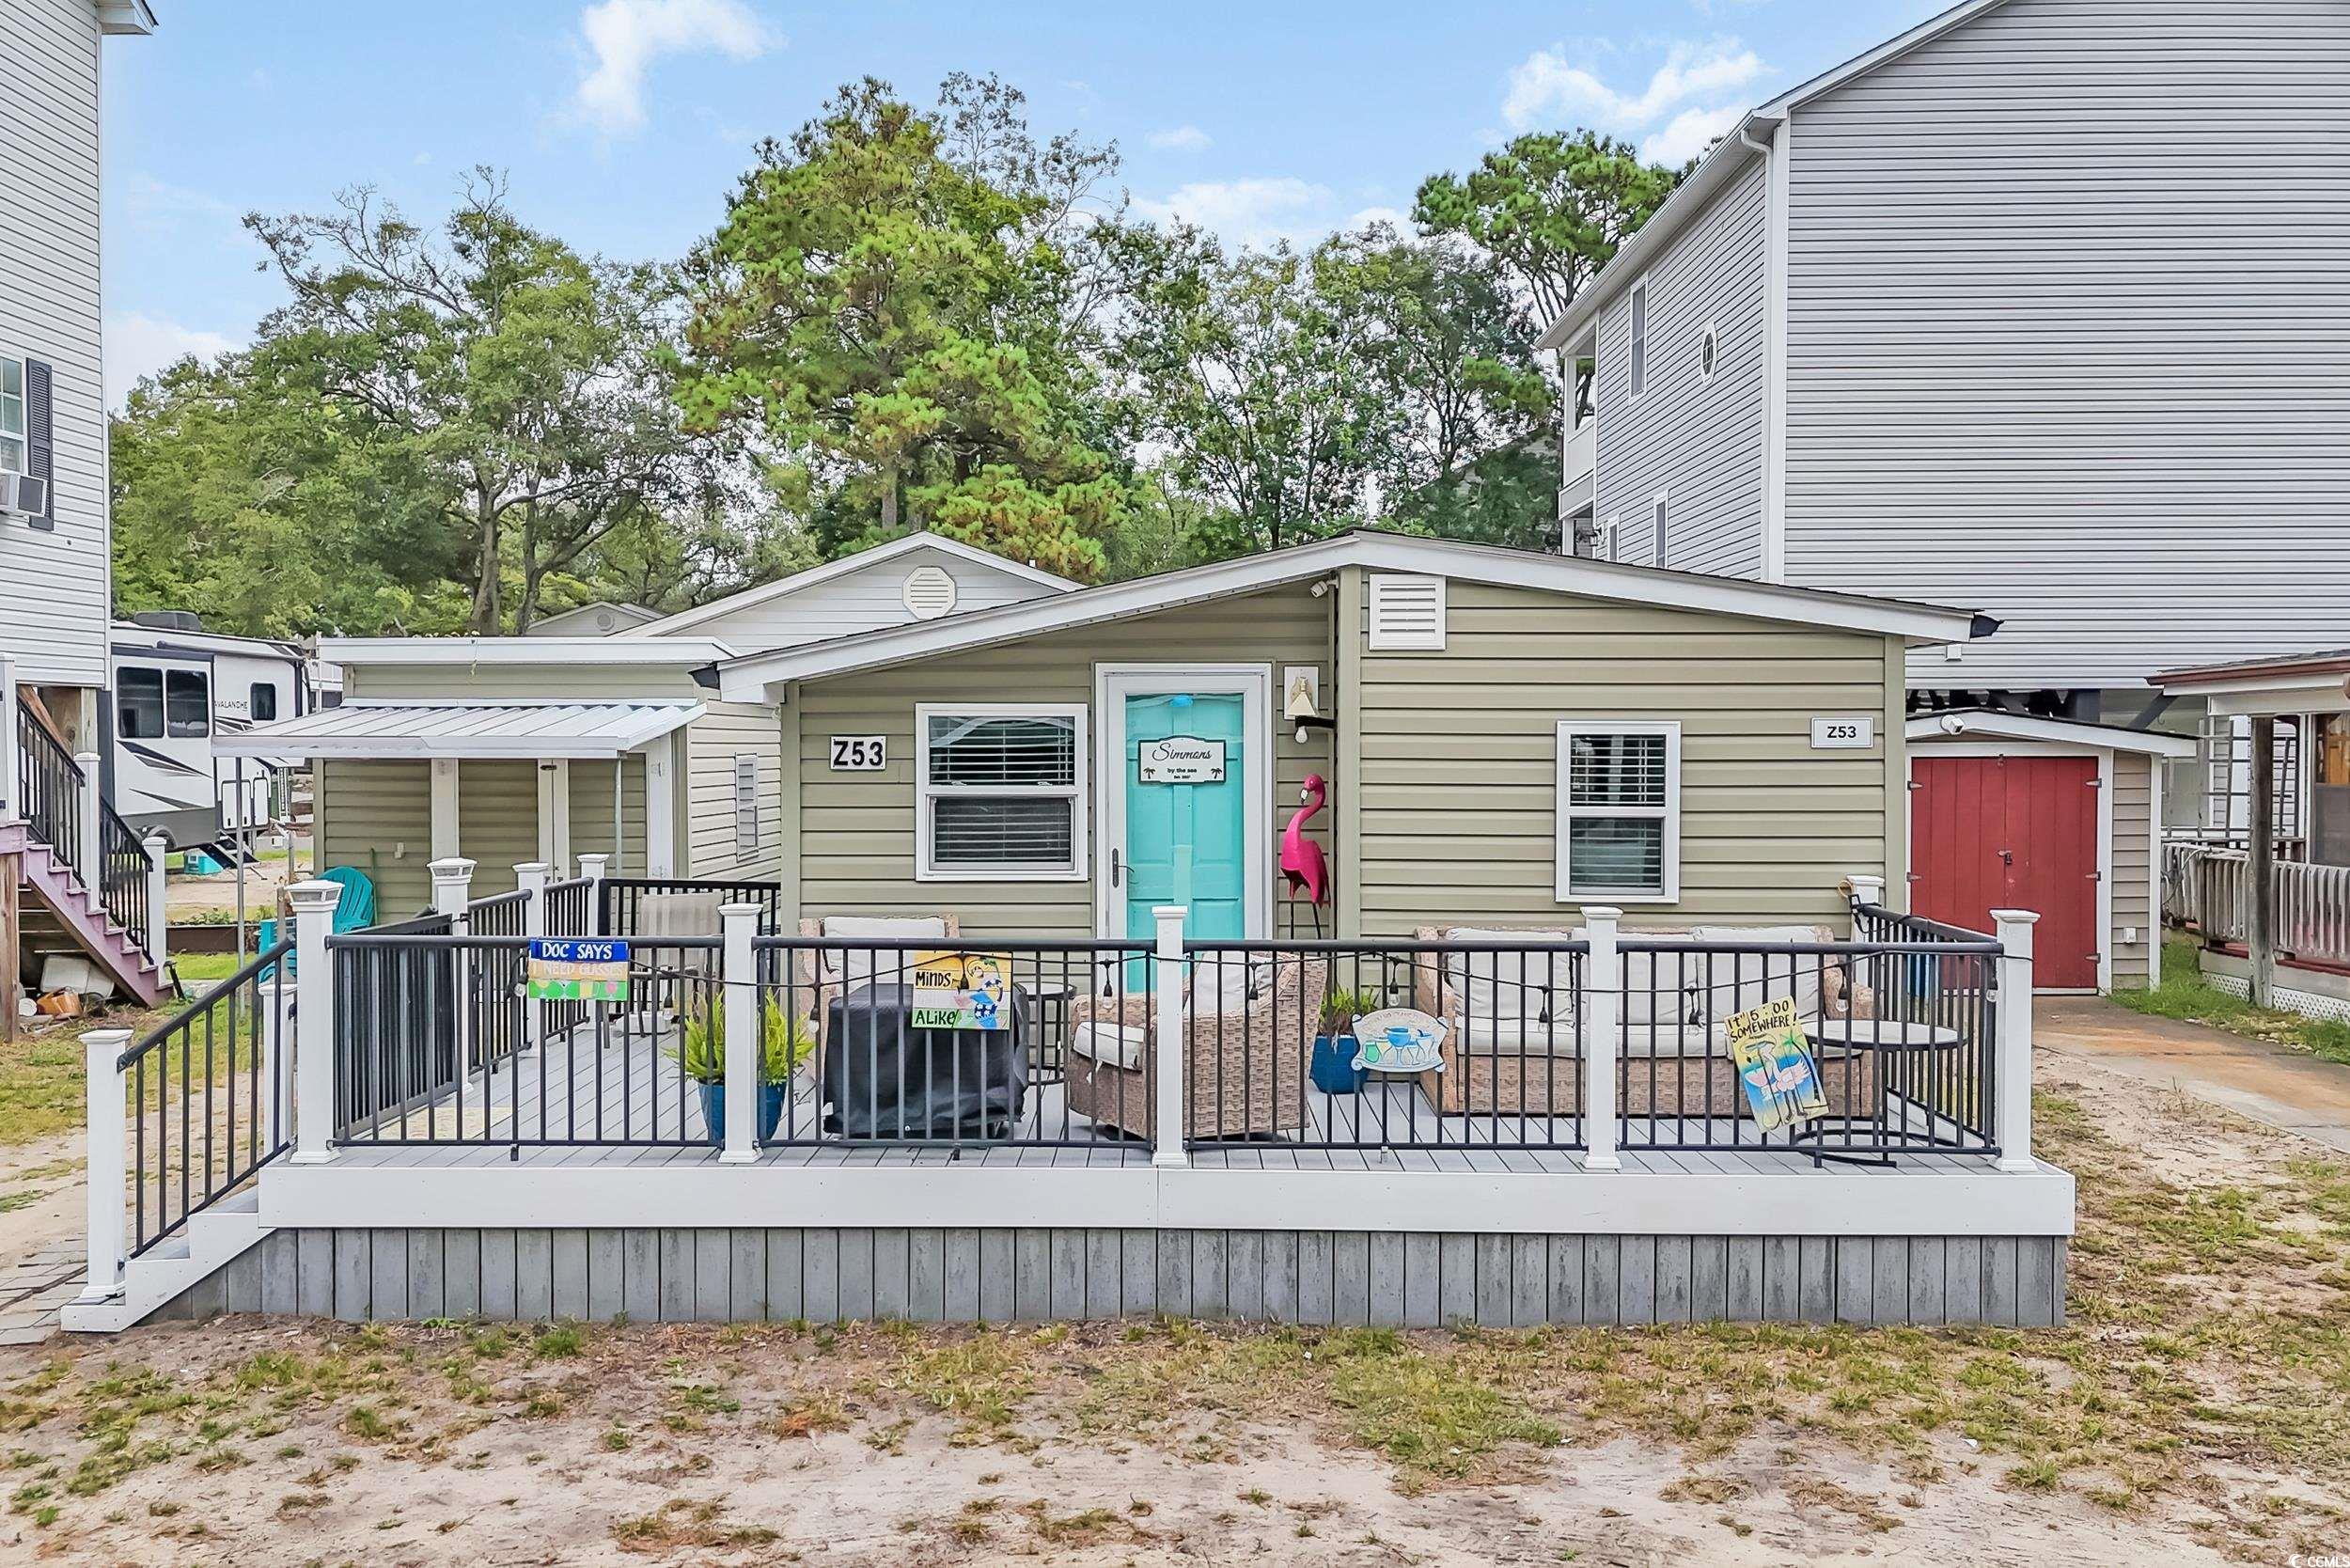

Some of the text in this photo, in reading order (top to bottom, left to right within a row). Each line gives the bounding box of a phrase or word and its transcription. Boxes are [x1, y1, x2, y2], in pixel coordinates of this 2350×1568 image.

[1827, 726, 1856, 739] Z53
[833, 740, 883, 766] Z53
[1152, 742, 1212, 761] Simmons
[542, 942, 613, 960] DOC SAYS
[543, 962, 574, 976] NEED
[1730, 1012, 1797, 1043] SOMEWHERE!
